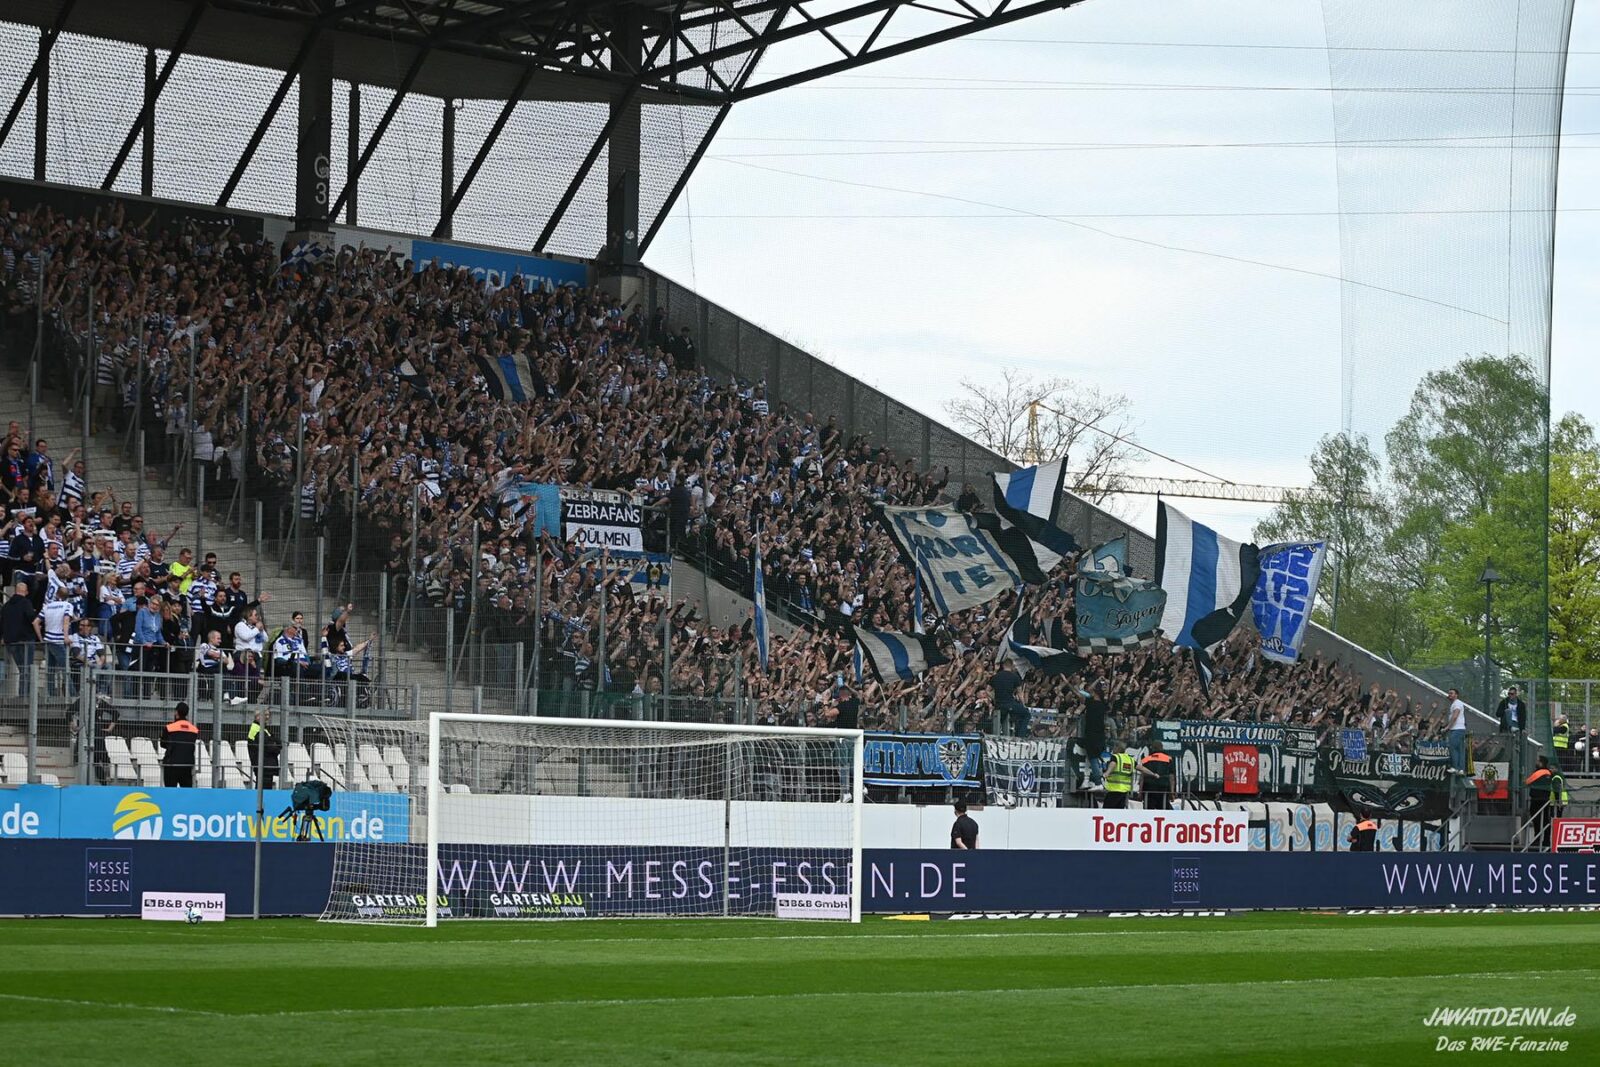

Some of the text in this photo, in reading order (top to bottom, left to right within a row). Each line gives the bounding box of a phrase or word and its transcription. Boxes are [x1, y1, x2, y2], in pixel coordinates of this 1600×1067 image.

[315, 182, 327, 204] 3
[566, 503, 640, 523] ZEBRAFANS
[578, 527, 631, 547] DÜLMEN
[985, 739, 1062, 761] RUHRPOTT
[1092, 816, 1246, 844] TerraTransfer
[89, 861, 130, 875] MESSE
[1173, 868, 1199, 879] MESSE
[89, 879, 130, 892] ESSEN
[1173, 882, 1199, 892] ESSEN
[157, 899, 223, 909] B&B GmbH
[352, 894, 449, 907] GARTENBU
[490, 894, 583, 906] GARTENBAU
[790, 899, 848, 909] B&B GmbH
